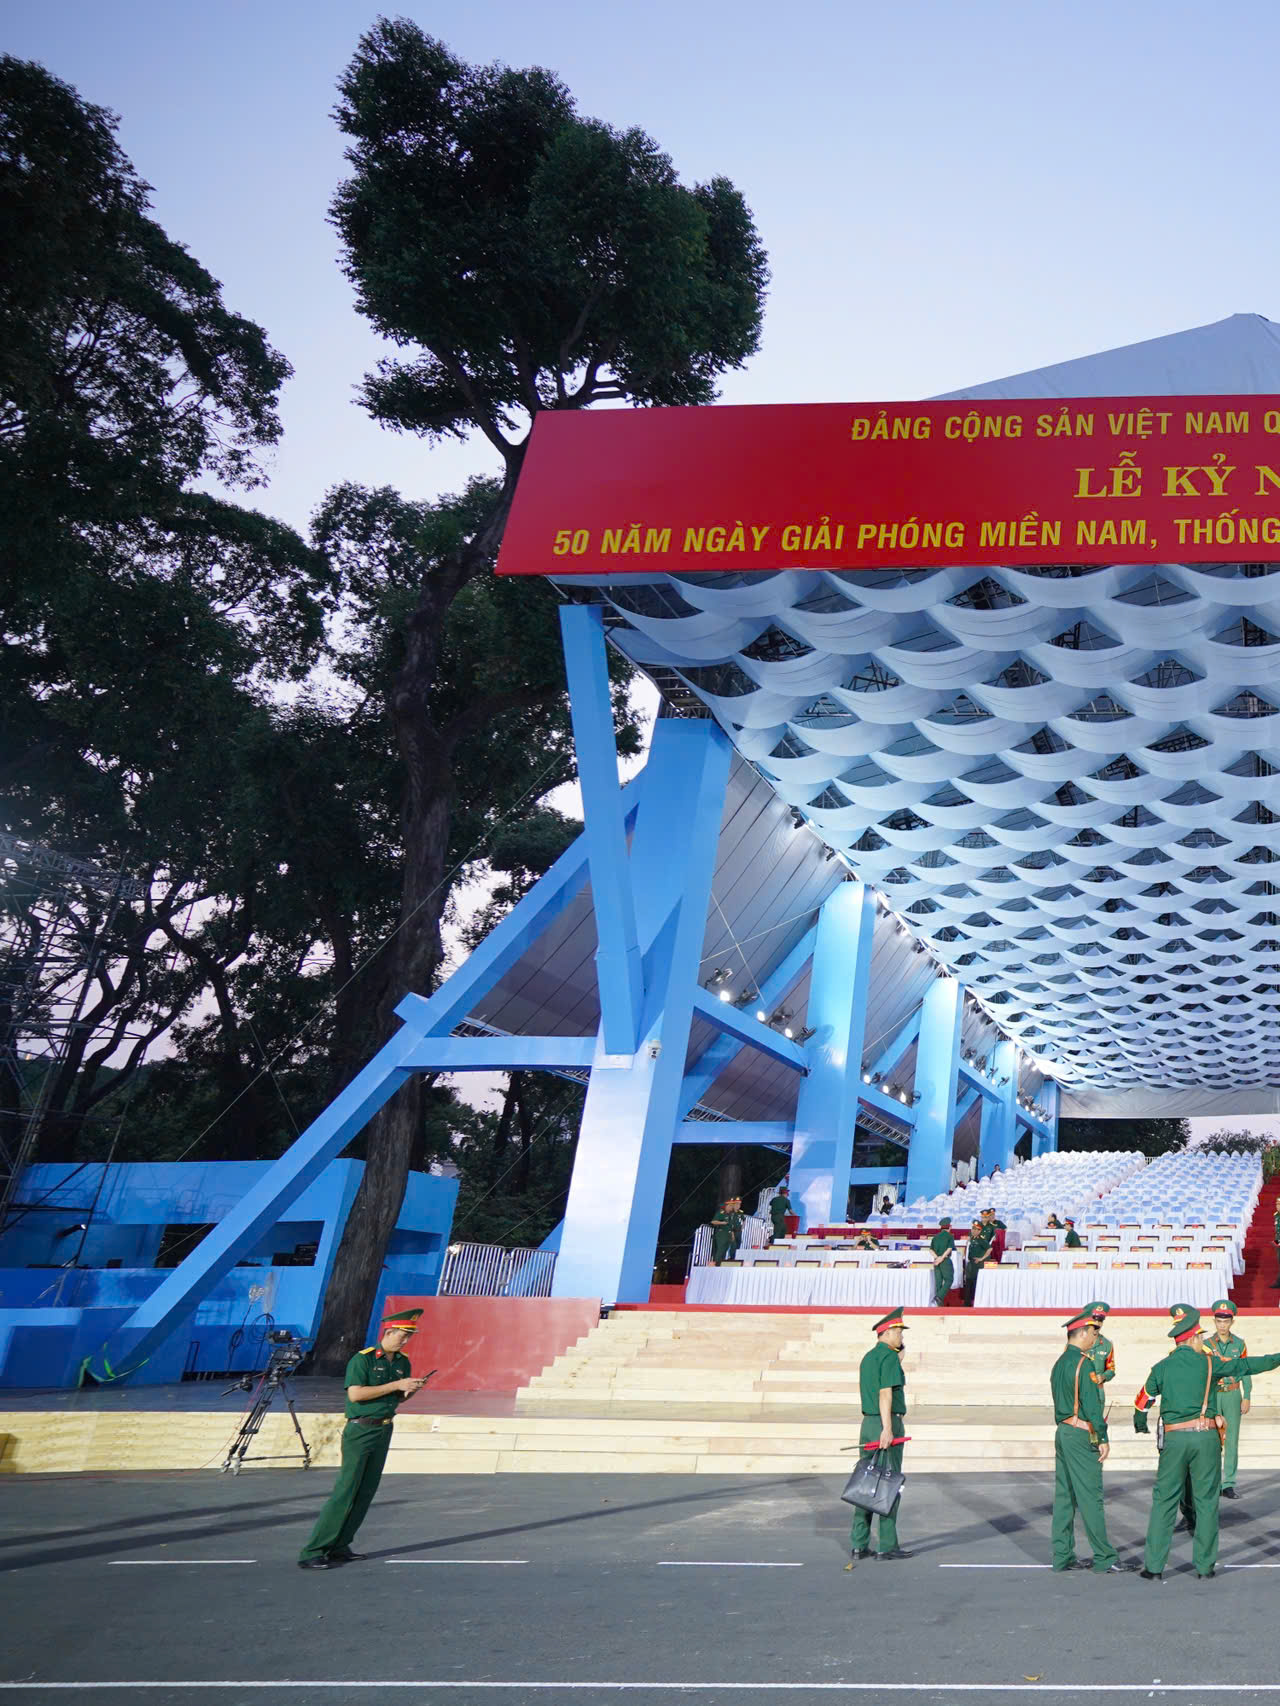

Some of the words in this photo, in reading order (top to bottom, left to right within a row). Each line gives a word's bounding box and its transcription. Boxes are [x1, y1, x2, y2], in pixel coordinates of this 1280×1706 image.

[850, 409, 932, 442] ĐẢNG
[944, 410, 1024, 444] CỘNG
[1035, 406, 1095, 437] SẢN
[1107, 407, 1174, 441] VIỆT
[1184, 411, 1250, 434] NAM
[1072, 450, 1142, 498] LỄ
[1160, 453, 1238, 497] KỶ
[552, 529, 591, 555] 50
[600, 523, 673, 554] NĂM
[682, 520, 771, 553] NGÀY
[780, 516, 845, 551] GIẢI
[856, 516, 966, 549] PHÓNG
[978, 511, 1063, 547] MIỀN
[1075, 519, 1158, 549] NAM,
